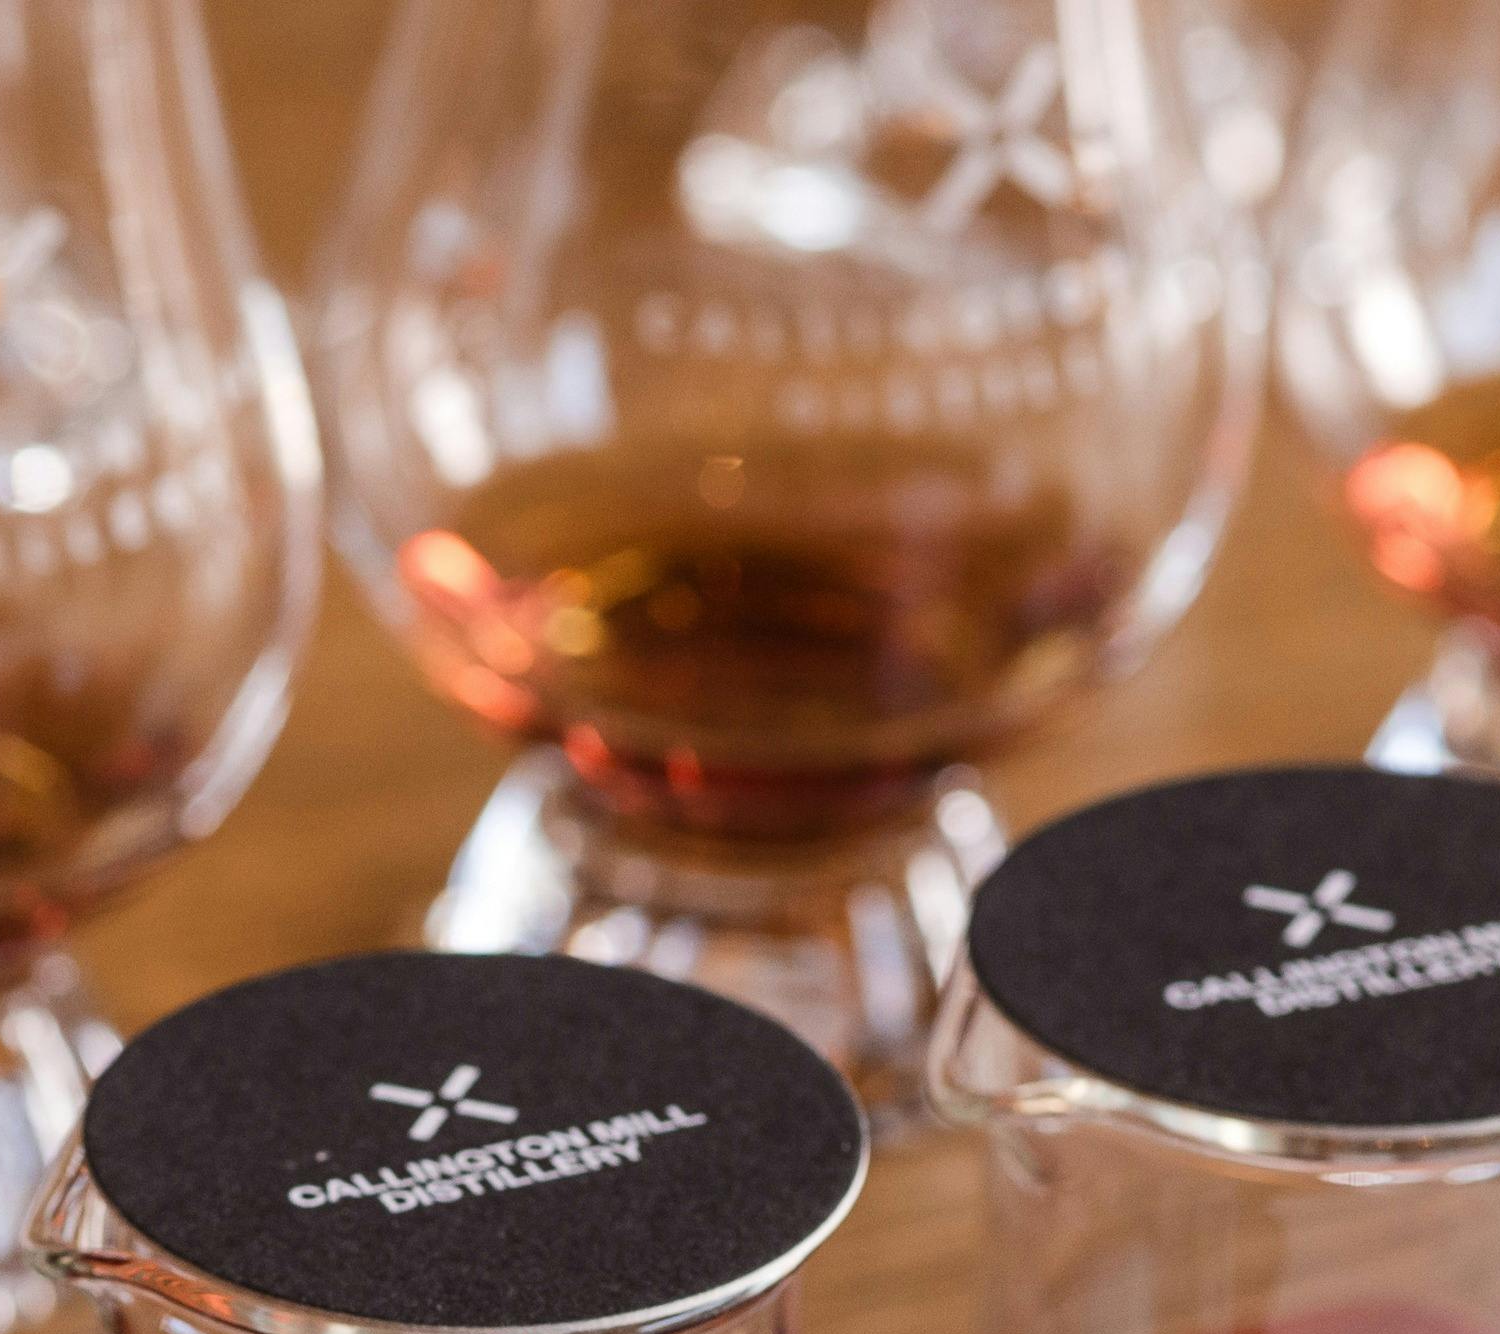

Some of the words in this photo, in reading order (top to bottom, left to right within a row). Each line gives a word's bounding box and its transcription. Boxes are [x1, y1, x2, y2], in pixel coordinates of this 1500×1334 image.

[288, 1127, 588, 1208] CALLINGTON
[587, 1104, 707, 1142] MILL
[380, 1140, 642, 1213] DISTILLERY
